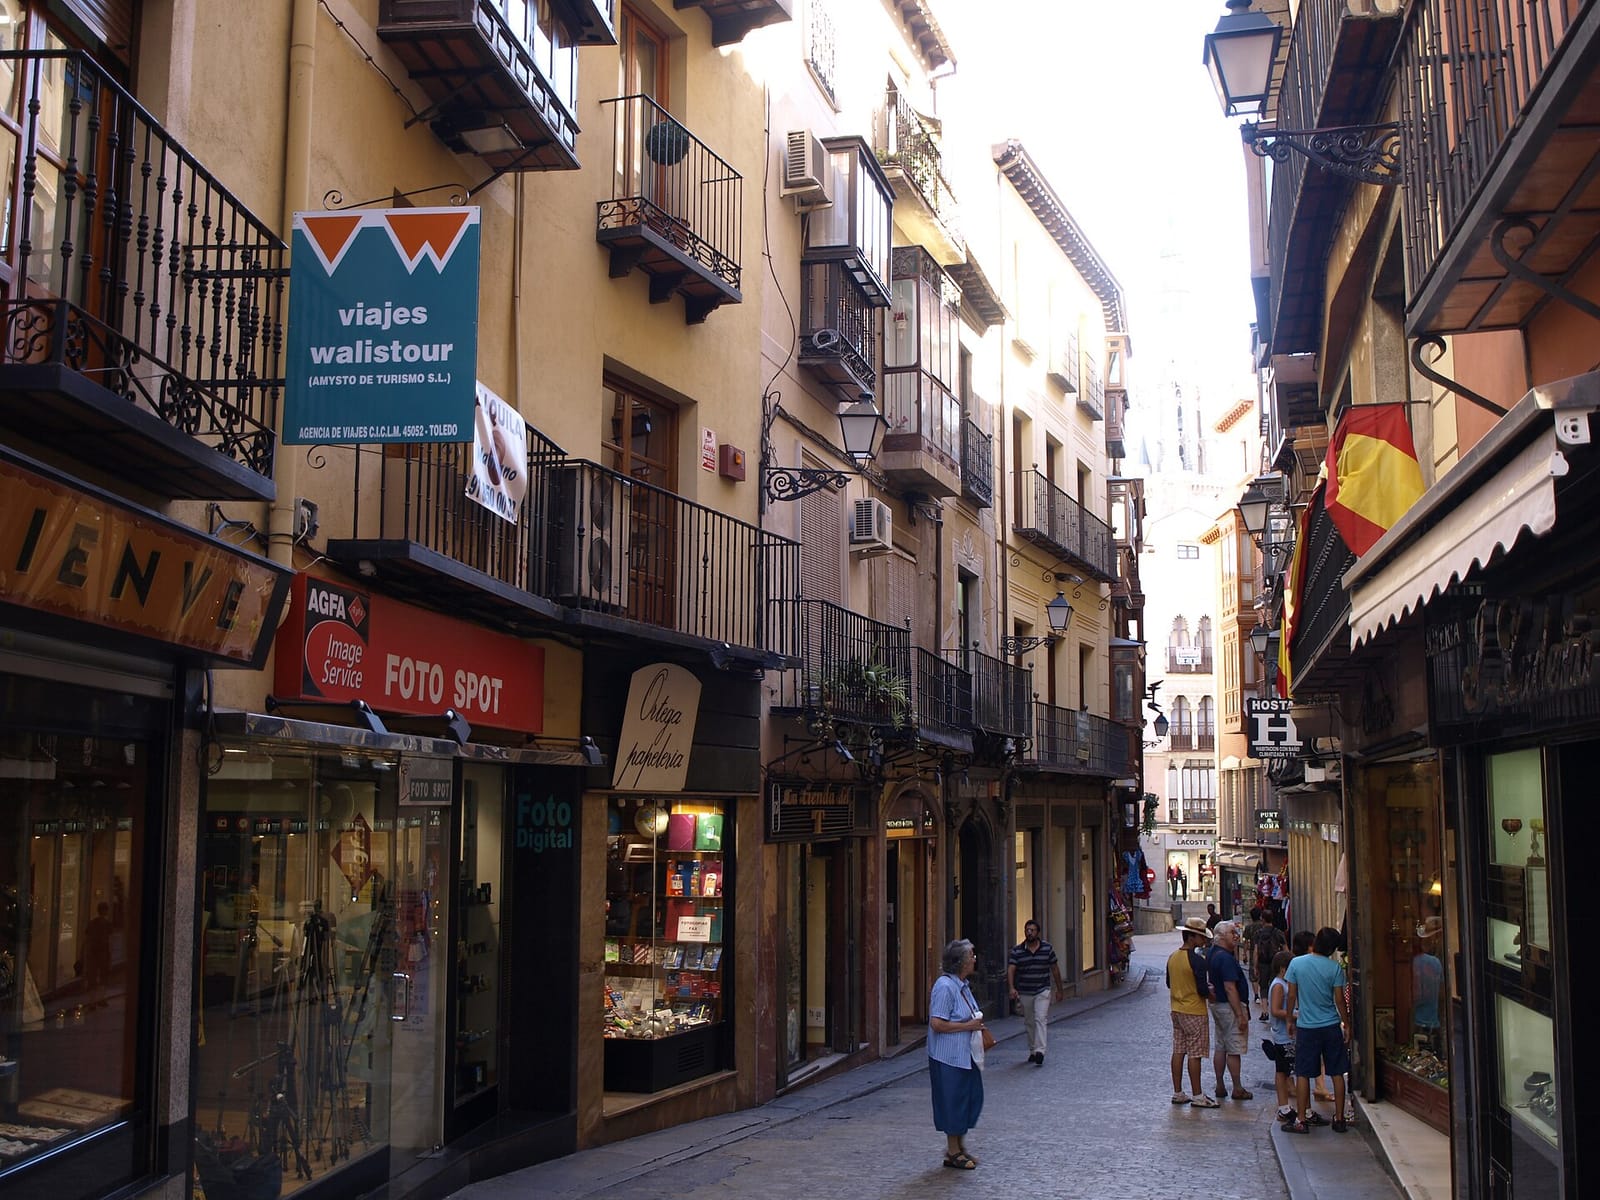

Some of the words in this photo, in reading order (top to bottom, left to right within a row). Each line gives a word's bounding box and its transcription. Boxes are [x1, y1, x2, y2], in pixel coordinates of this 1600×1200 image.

[338, 301, 428, 330] viajes
[310, 339, 453, 364] walistour
[308, 375, 357, 388] (AMYSTO
[360, 375, 373, 385] DE
[376, 373, 425, 385] TURISMO
[427, 372, 451, 385] S.L.)
[299, 426, 330, 439] AGENCIA
[331, 426, 342, 438] DE
[343, 426, 368, 438] VIAJES
[403, 424, 424, 436] 45052
[429, 423, 458, 436] TOLEDO
[475, 392, 523, 441] LQUILA
[308, 587, 346, 620] AGFA
[327, 633, 363, 668] Image
[321, 659, 363, 689] Service
[385, 653, 444, 705] FOTO
[454, 669, 502, 714] SPOT
[640, 667, 682, 746] Ortega
[1252, 700, 1294, 710] HOSTA
[1252, 713, 1303, 746] H
[616, 732, 684, 789] papeleria
[410, 782, 429, 798] FOTO
[433, 782, 450, 798] SPOT
[517, 794, 572, 827] Foto
[516, 827, 572, 853] Digital
